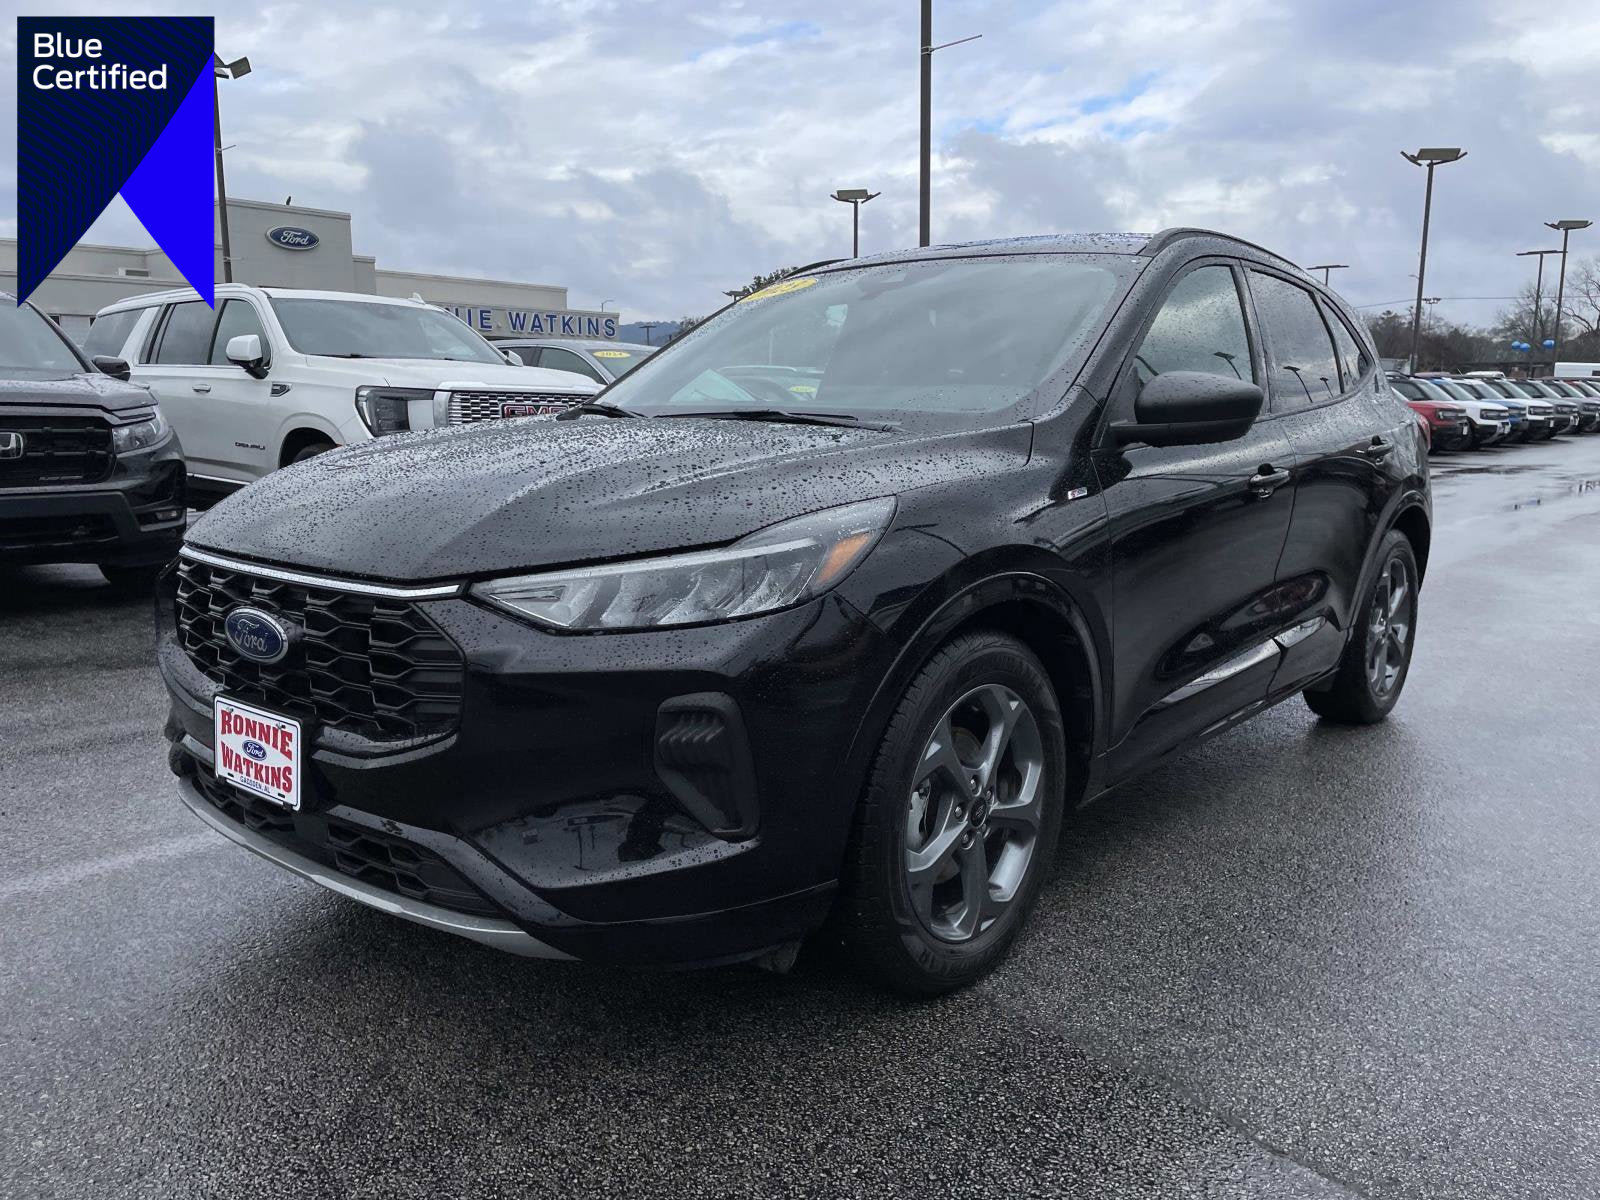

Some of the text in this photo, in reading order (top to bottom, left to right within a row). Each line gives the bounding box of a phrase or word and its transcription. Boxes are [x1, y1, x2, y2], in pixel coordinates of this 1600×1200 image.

[281, 230, 310, 245] Ford
[508, 311, 616, 337] WATKINS
[235, 619, 268, 652] Ford
[220, 709, 293, 761] RONNIE
[245, 743, 265, 758] Ford
[220, 740, 293, 794] WATKINS
